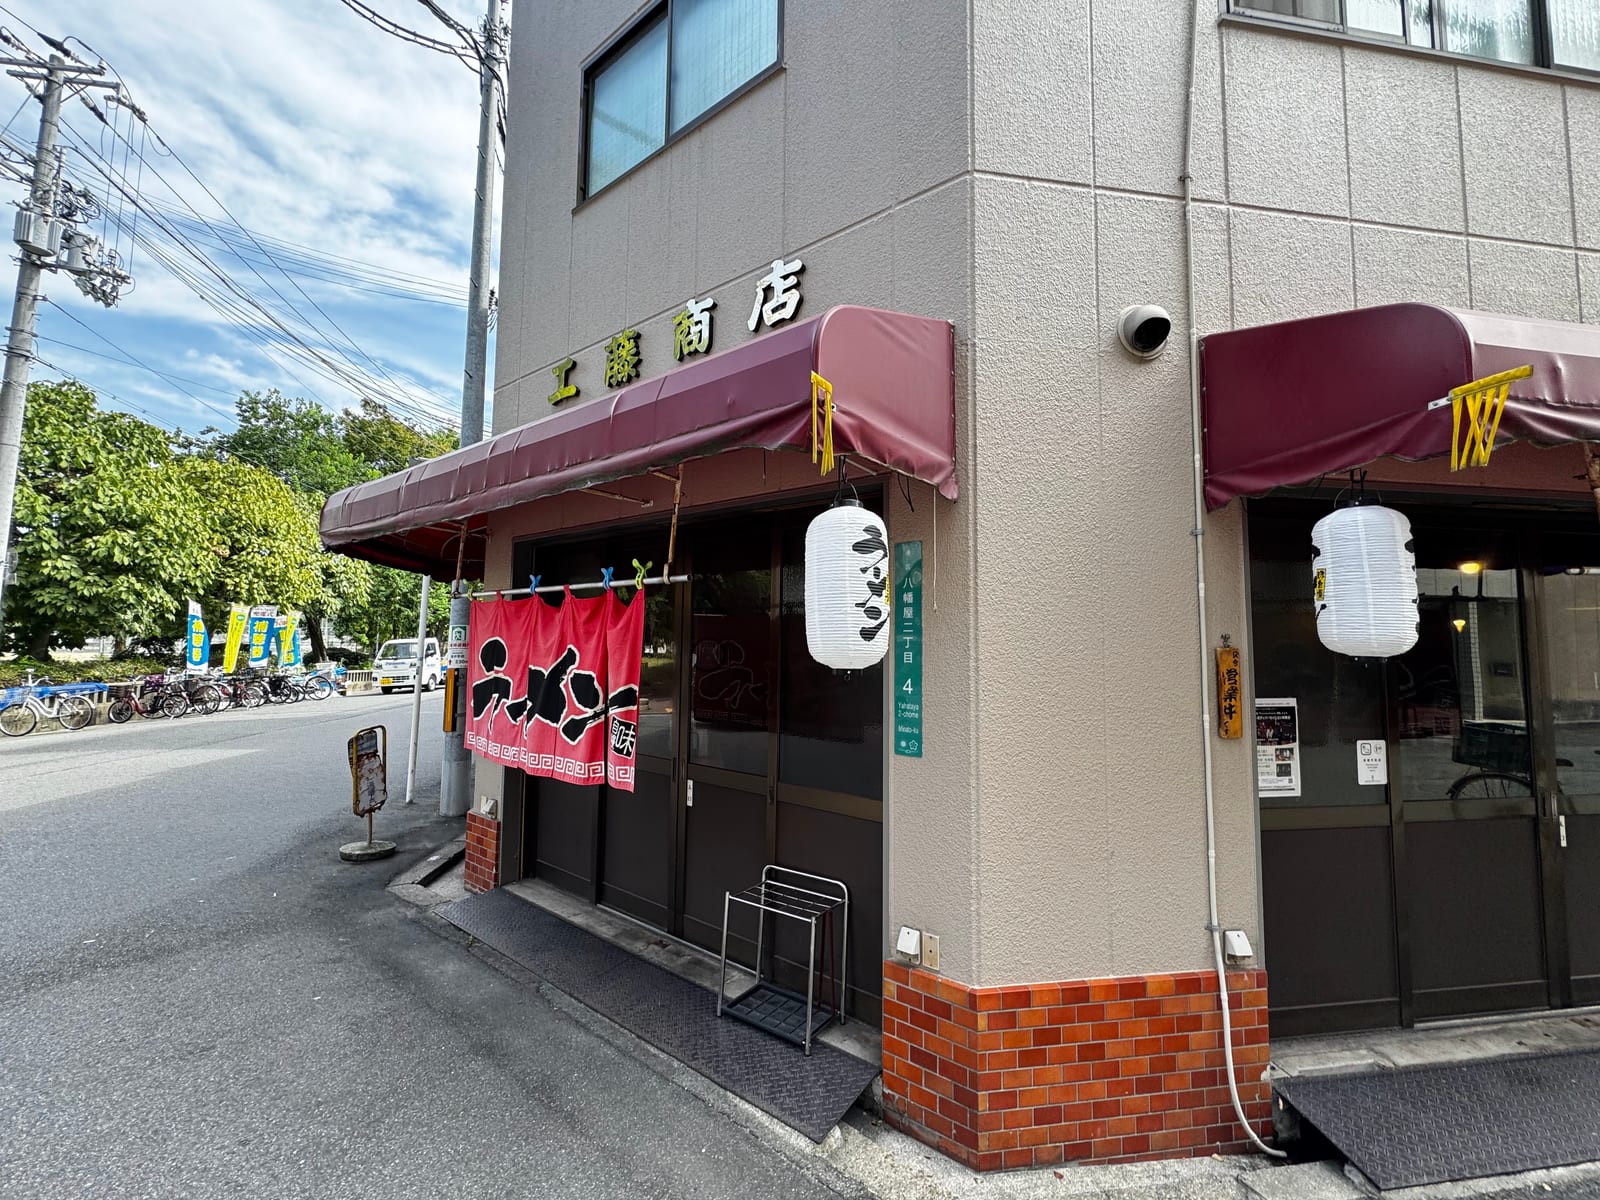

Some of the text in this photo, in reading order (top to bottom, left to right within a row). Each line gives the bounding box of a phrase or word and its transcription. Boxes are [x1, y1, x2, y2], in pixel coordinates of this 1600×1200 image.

[547, 258, 806, 406] 工藤商店
[902, 577, 914, 664] 八幡屋二丁目
[902, 677, 914, 695] 4
[1223, 667, 1239, 721] 営業中
